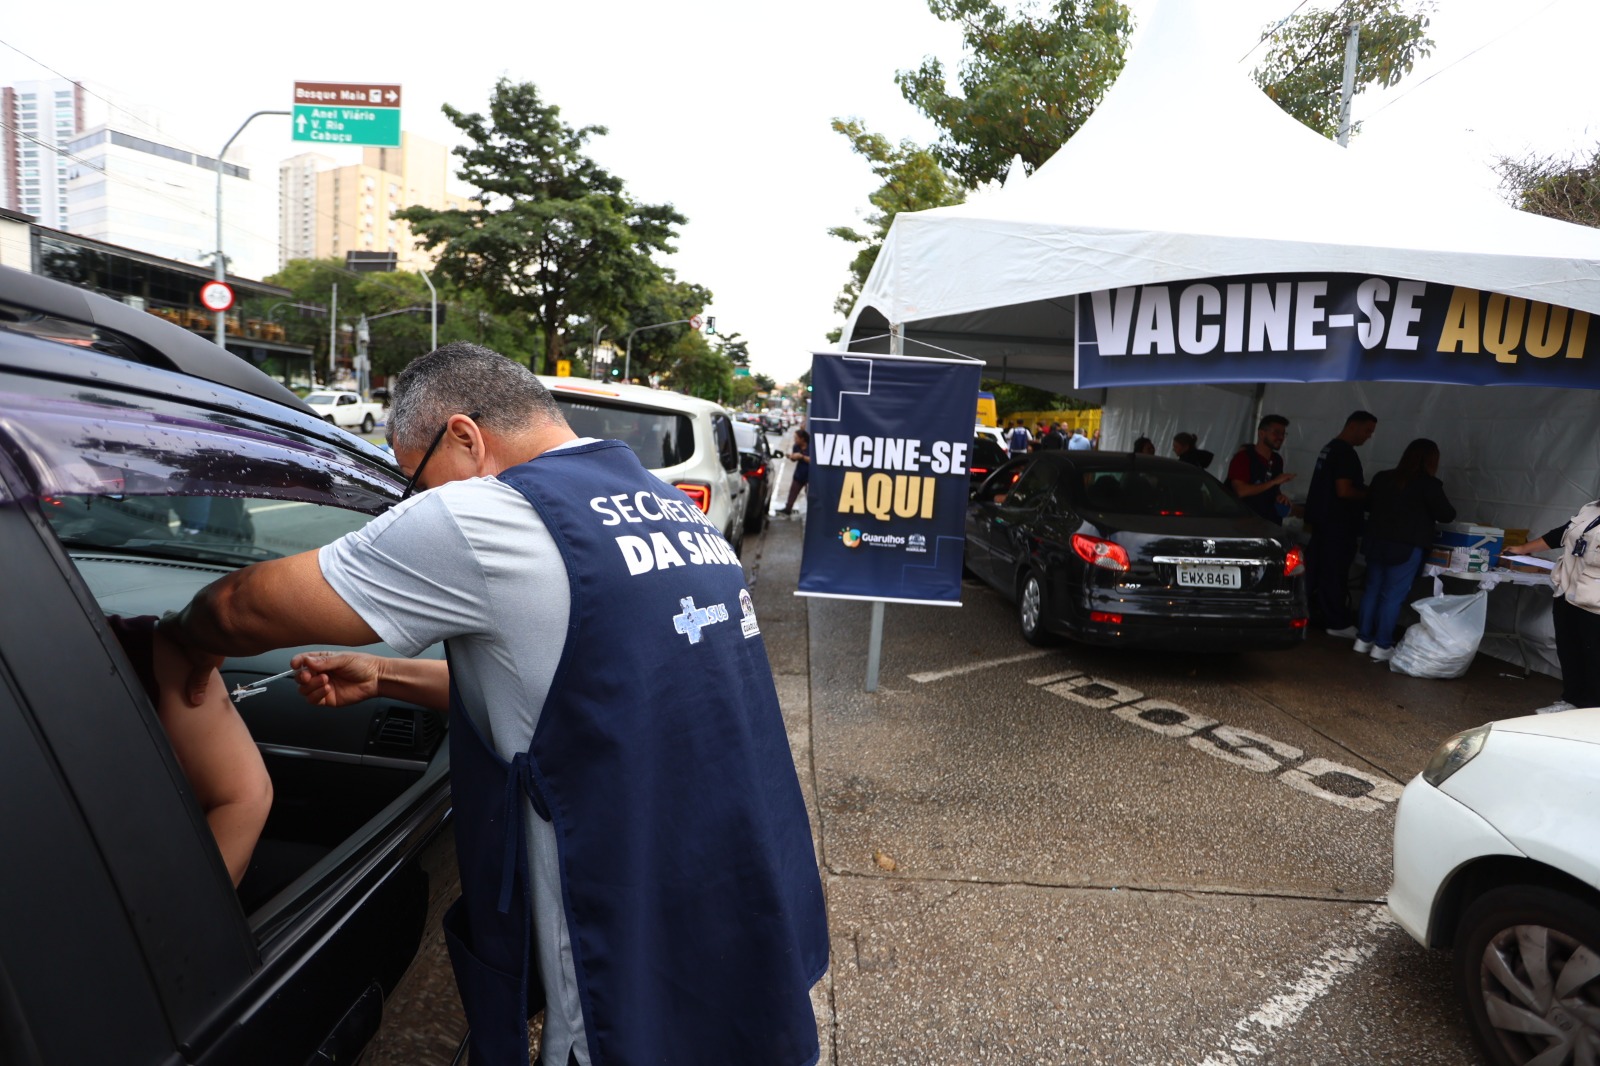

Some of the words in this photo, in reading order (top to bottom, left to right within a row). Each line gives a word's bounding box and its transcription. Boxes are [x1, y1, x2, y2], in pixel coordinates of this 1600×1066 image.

[296, 88, 337, 101] Bosque
[340, 90, 367, 101] Maia
[311, 109, 338, 119] Anel
[342, 109, 376, 121] Viário
[311, 119, 321, 129] V.
[325, 121, 344, 131] Rio
[310, 130, 352, 142] Cabuçu
[1091, 278, 1426, 356] VACINE-SE
[1436, 285, 1590, 364] AQUI
[814, 433, 968, 475] VACINE-SE
[589, 490, 720, 533] SECRETAR
[837, 471, 936, 522] AQUI
[615, 531, 686, 577] DA
[862, 532, 905, 545] Guarulhos
[707, 603, 729, 625] SUS
[1026, 670, 1403, 813] IDOSO
